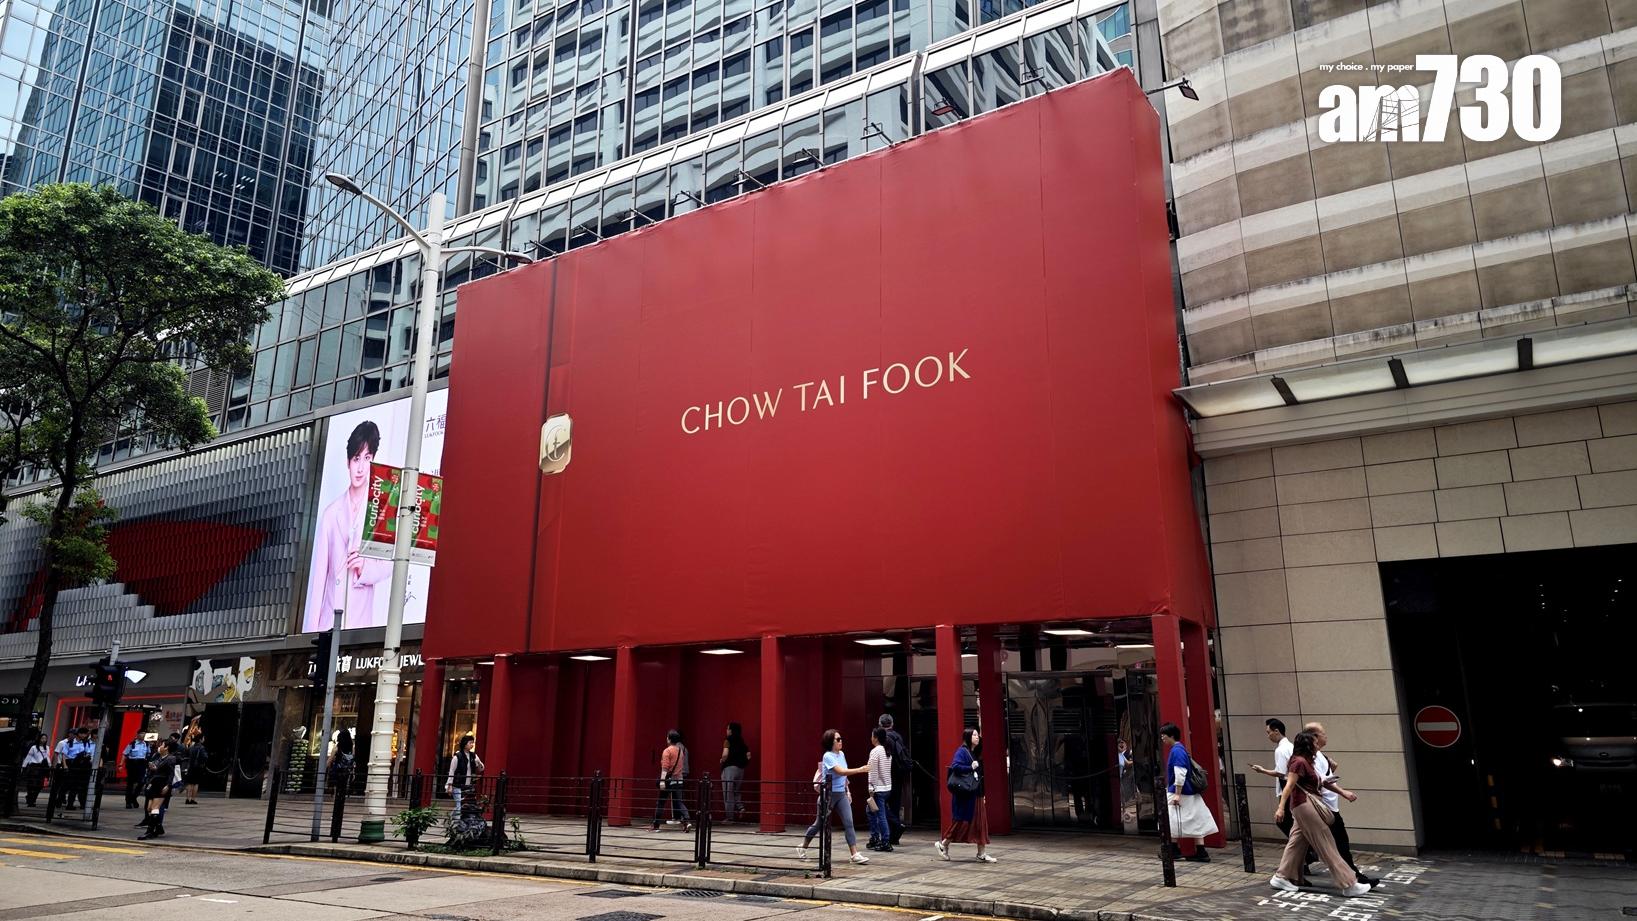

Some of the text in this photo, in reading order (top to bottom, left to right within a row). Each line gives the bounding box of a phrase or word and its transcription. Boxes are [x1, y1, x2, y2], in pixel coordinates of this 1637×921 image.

[680, 347, 972, 435] CHOW TAI FOOK
[369, 475, 384, 527] curiocity
